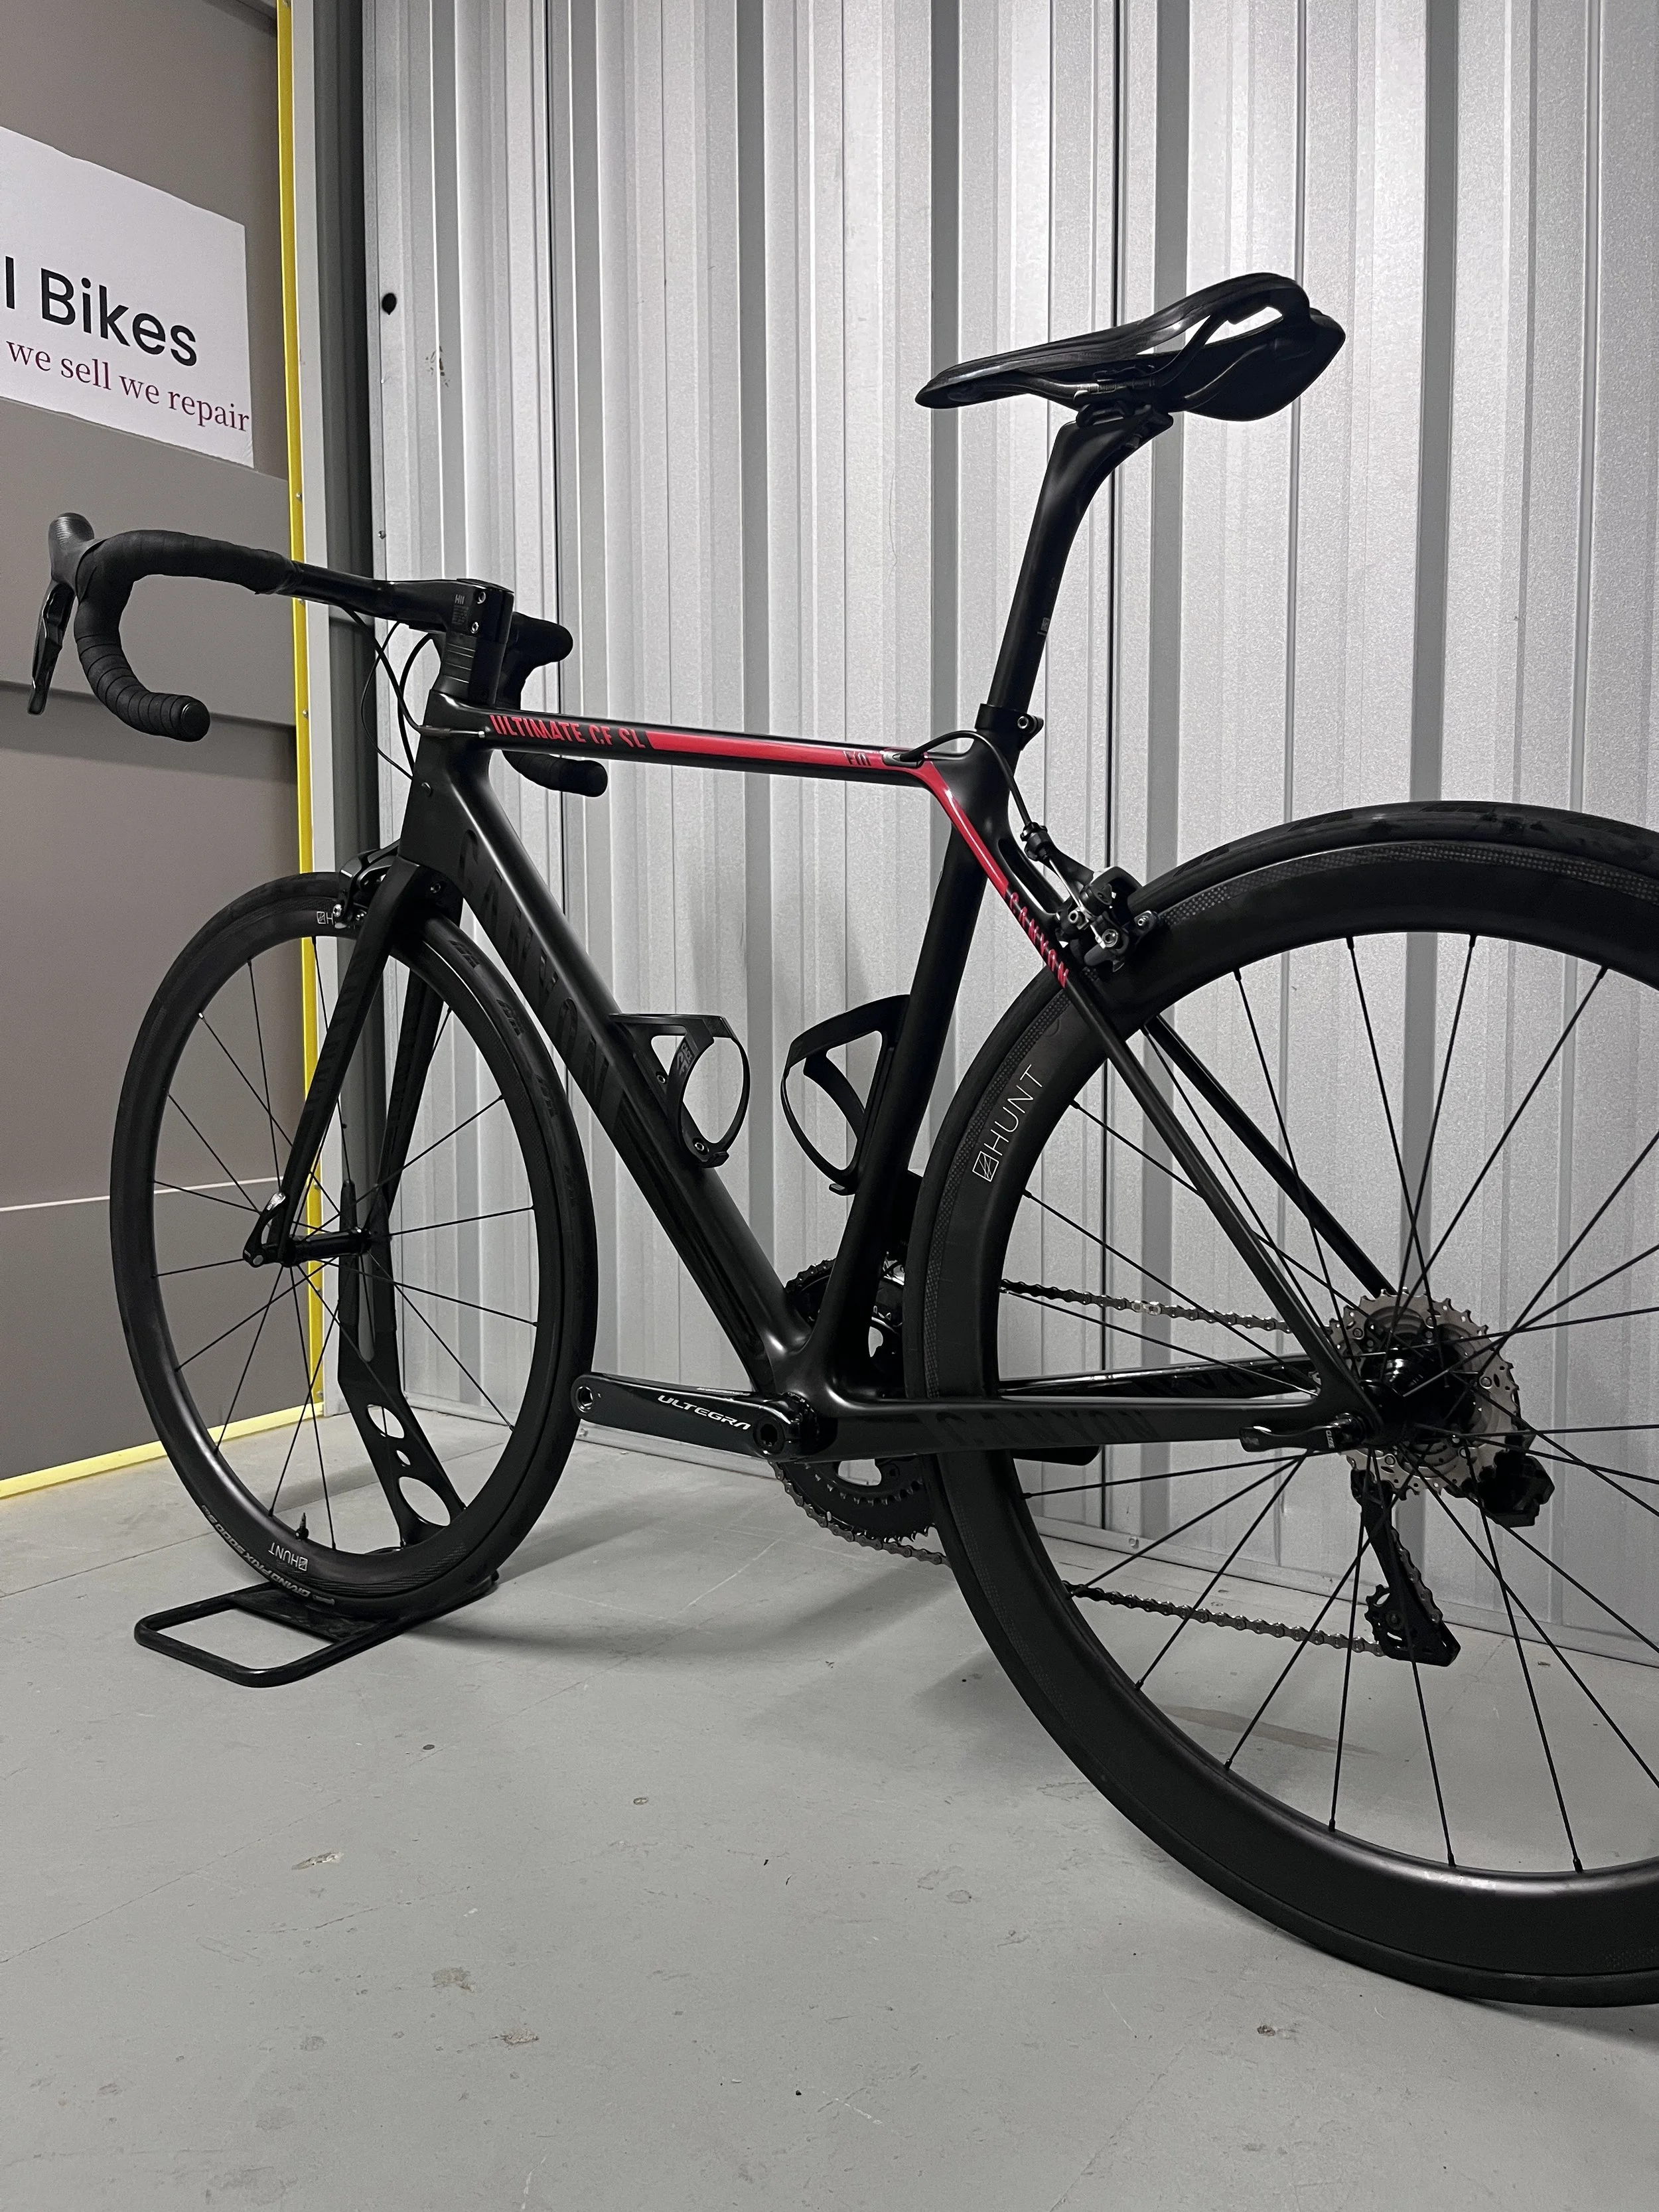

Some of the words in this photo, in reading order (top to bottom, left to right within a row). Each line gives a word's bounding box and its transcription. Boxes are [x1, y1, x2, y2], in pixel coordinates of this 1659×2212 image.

[41, 267, 197, 366] Bikes
[6, 341, 51, 372] we
[61, 358, 111, 390] sell
[119, 376, 160, 404] we
[168, 392, 250, 432] repair
[490, 715, 585, 743] ULTIMATE
[588, 725, 612, 745] CF
[617, 727, 646, 749] SL
[1009, 892, 1070, 989] CANYON
[983, 1065, 1043, 1157] HUNT
[657, 1394, 751, 1430] ULTEGRA
[214, 1523, 246, 1554] 5000
[268, 1542, 299, 1568] HUNT
[243, 1551, 273, 1576] PRIX
[271, 1572, 311, 1598] GRAND
